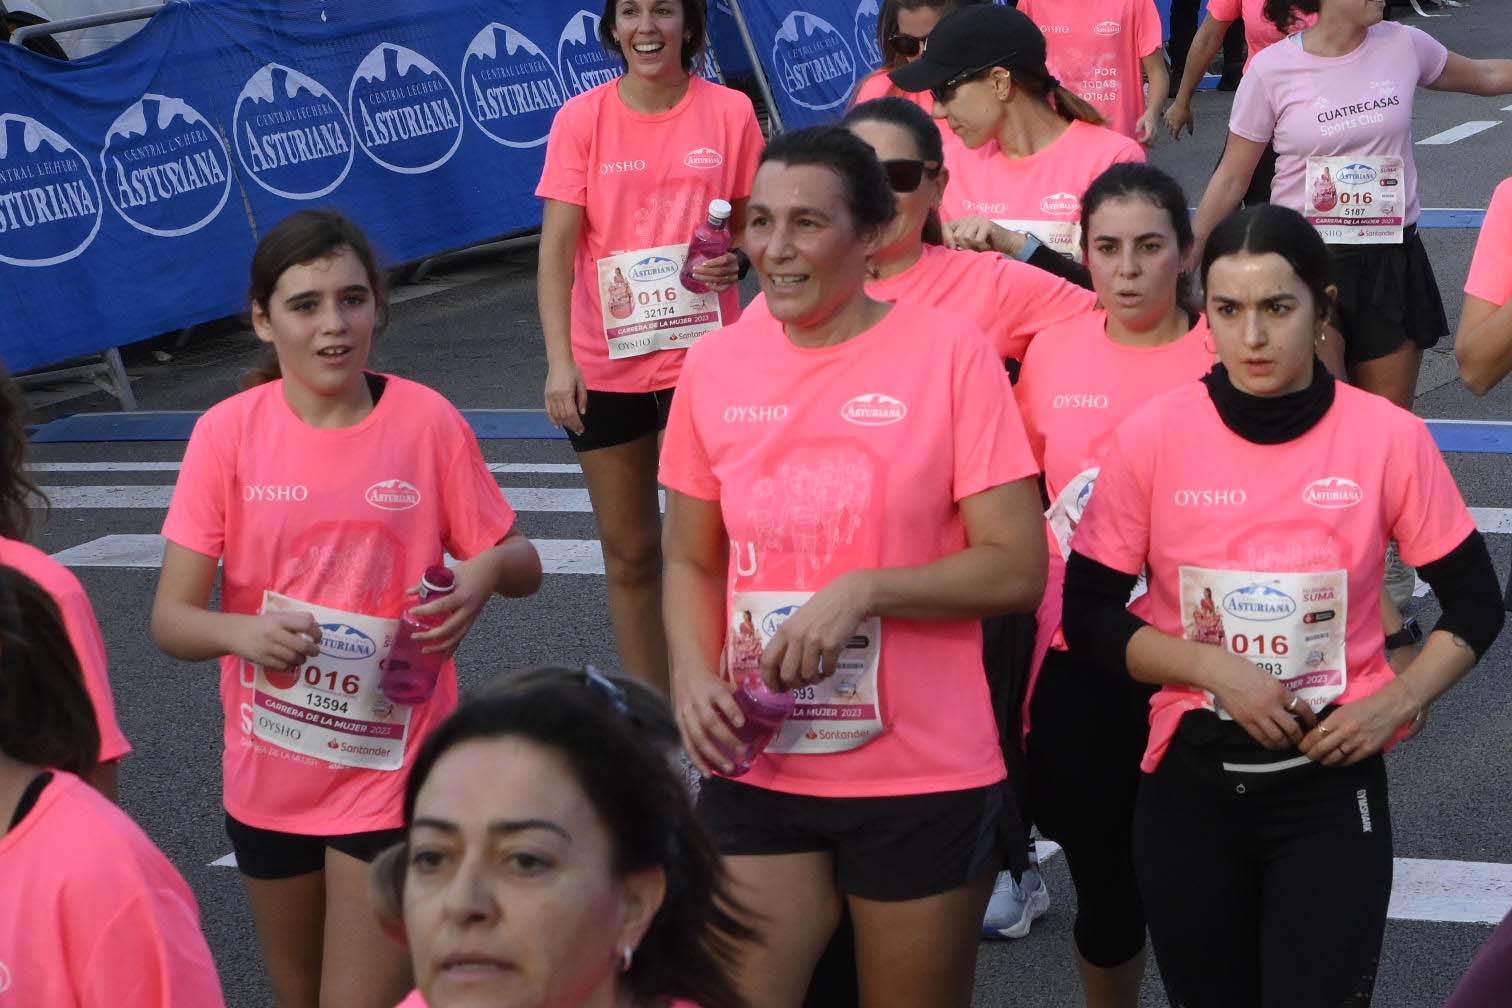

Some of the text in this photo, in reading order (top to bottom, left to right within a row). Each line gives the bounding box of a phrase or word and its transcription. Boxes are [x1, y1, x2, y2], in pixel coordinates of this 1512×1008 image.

[480, 65, 514, 81] CENTRAL
[1094, 67, 1117, 77] POR
[369, 79, 444, 105] CENTRAL LECHERA
[1083, 79, 1117, 89] TODAS
[471, 74, 564, 122] ASTURIANA
[1079, 92, 1117, 102] OTRAS
[1317, 95, 1400, 123] CUATRECASAS
[358, 96, 460, 147] ASTURIANA
[1319, 112, 1384, 137] Sports Club
[245, 119, 350, 173] ASTURIANA
[600, 159, 646, 175] OYSHO
[1340, 192, 1373, 204] 016
[1344, 208, 1366, 216] 5187
[631, 263, 675, 279] ASTURIANA
[638, 287, 677, 306] 016
[643, 306, 675, 319] 32174
[617, 323, 647, 335] CARRERA
[647, 321, 658, 330] DE
[659, 319, 668, 327] LA
[669, 317, 692, 327] MUJER
[1053, 394, 1108, 410] OYSHO
[724, 404, 788, 423] OYSHO
[243, 485, 308, 502] OYSHO
[1174, 489, 1246, 506] OYSHO
[732, 539, 757, 577] U
[1228, 597, 1291, 613] ASTURIANA
[1303, 591, 1335, 603] SUMA
[1231, 633, 1289, 656] 016
[304, 665, 360, 695] 016
[1306, 674, 1328, 684] 2023
[306, 693, 349, 714] 13594
[265, 699, 391, 735] CARRERA DE LA MUJER 2023
[792, 708, 862, 717] LA MUJER 2023
[258, 716, 302, 741] OYSHO
[819, 727, 870, 740] Santander
[340, 742, 392, 757] Santander
